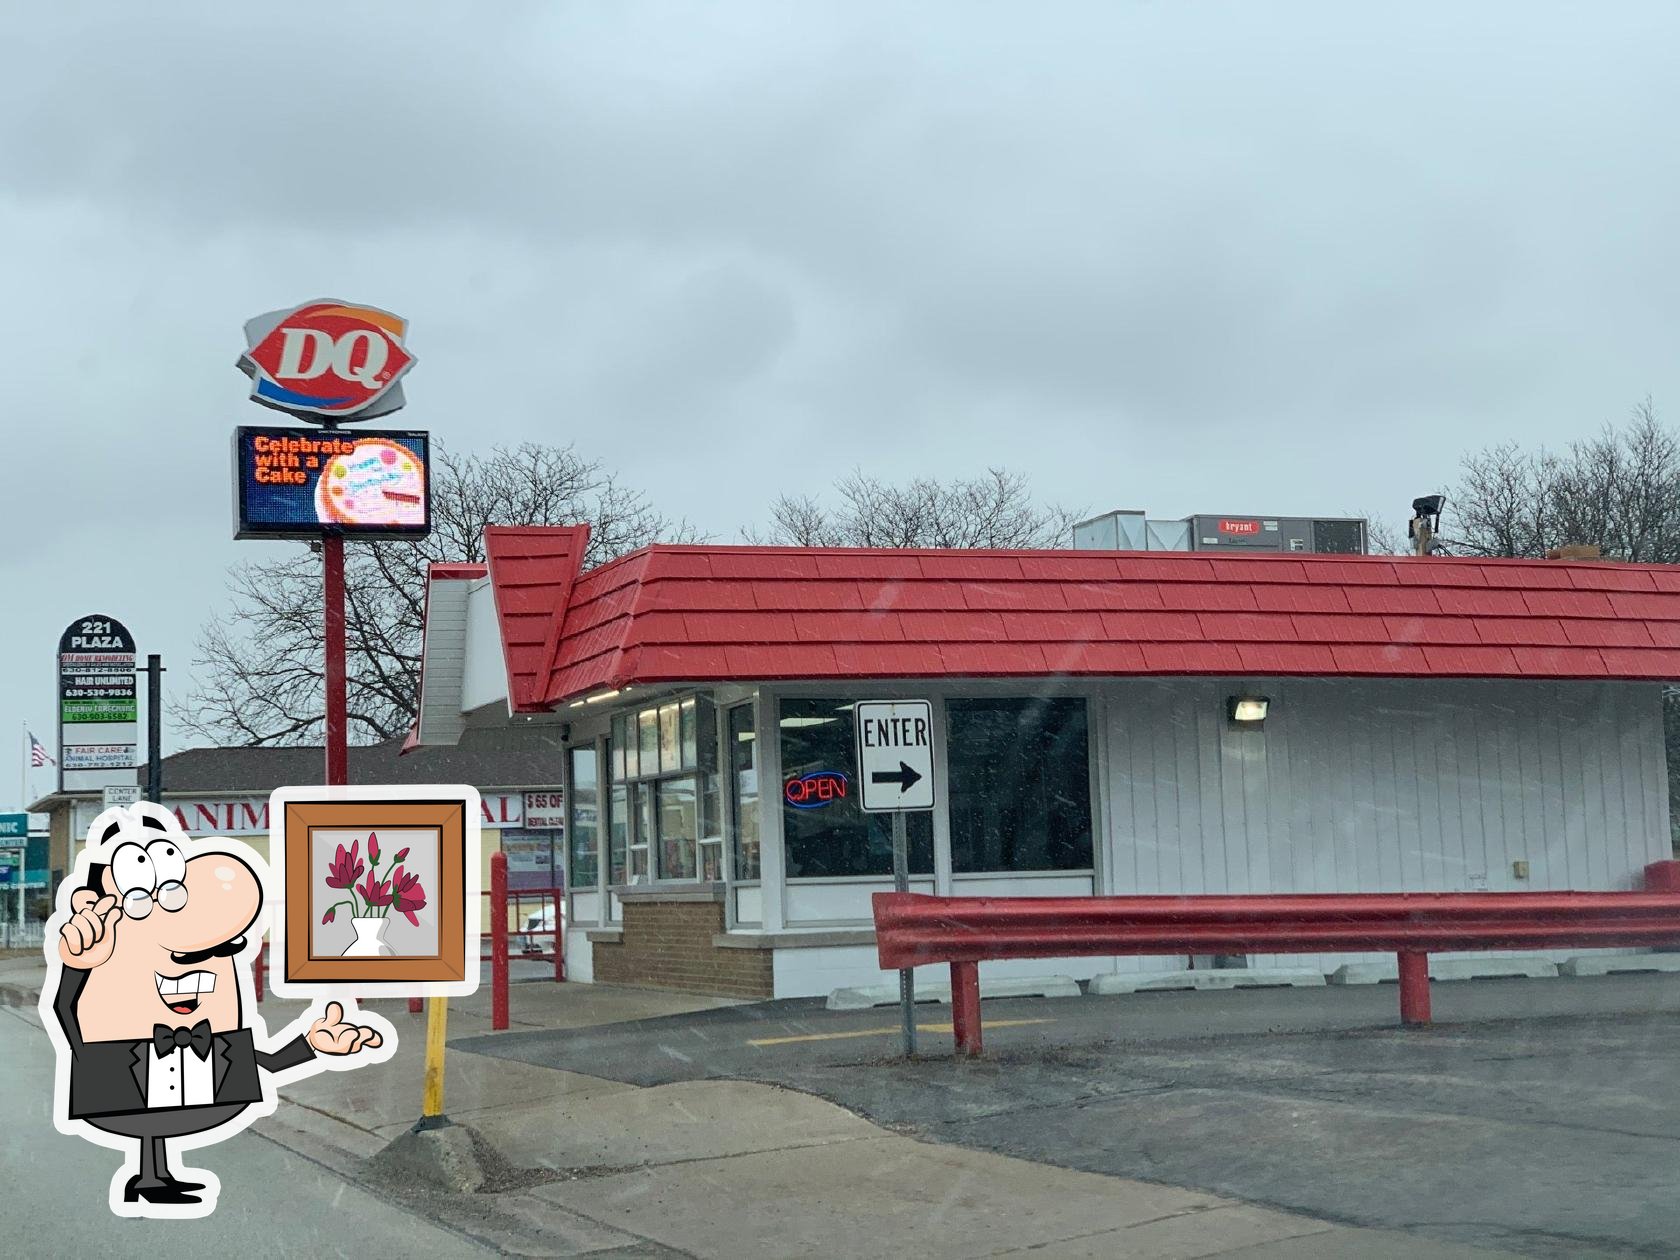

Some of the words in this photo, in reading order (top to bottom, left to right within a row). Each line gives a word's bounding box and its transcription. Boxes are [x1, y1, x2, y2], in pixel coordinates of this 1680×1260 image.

[276, 327, 389, 390] DQ
[254, 436, 355, 455] Celebrate
[255, 452, 300, 468] with
[305, 456, 319, 468] a
[254, 466, 307, 484] Cake
[1225, 521, 1252, 533] bryant
[81, 621, 111, 634] 221
[71, 636, 124, 648] PLAZA
[75, 676, 94, 686] HAIR
[94, 676, 134, 686] UNLIMITED
[863, 717, 928, 748] ENTER
[97, 746, 123, 754] CARE
[785, 778, 847, 802] OPEN
